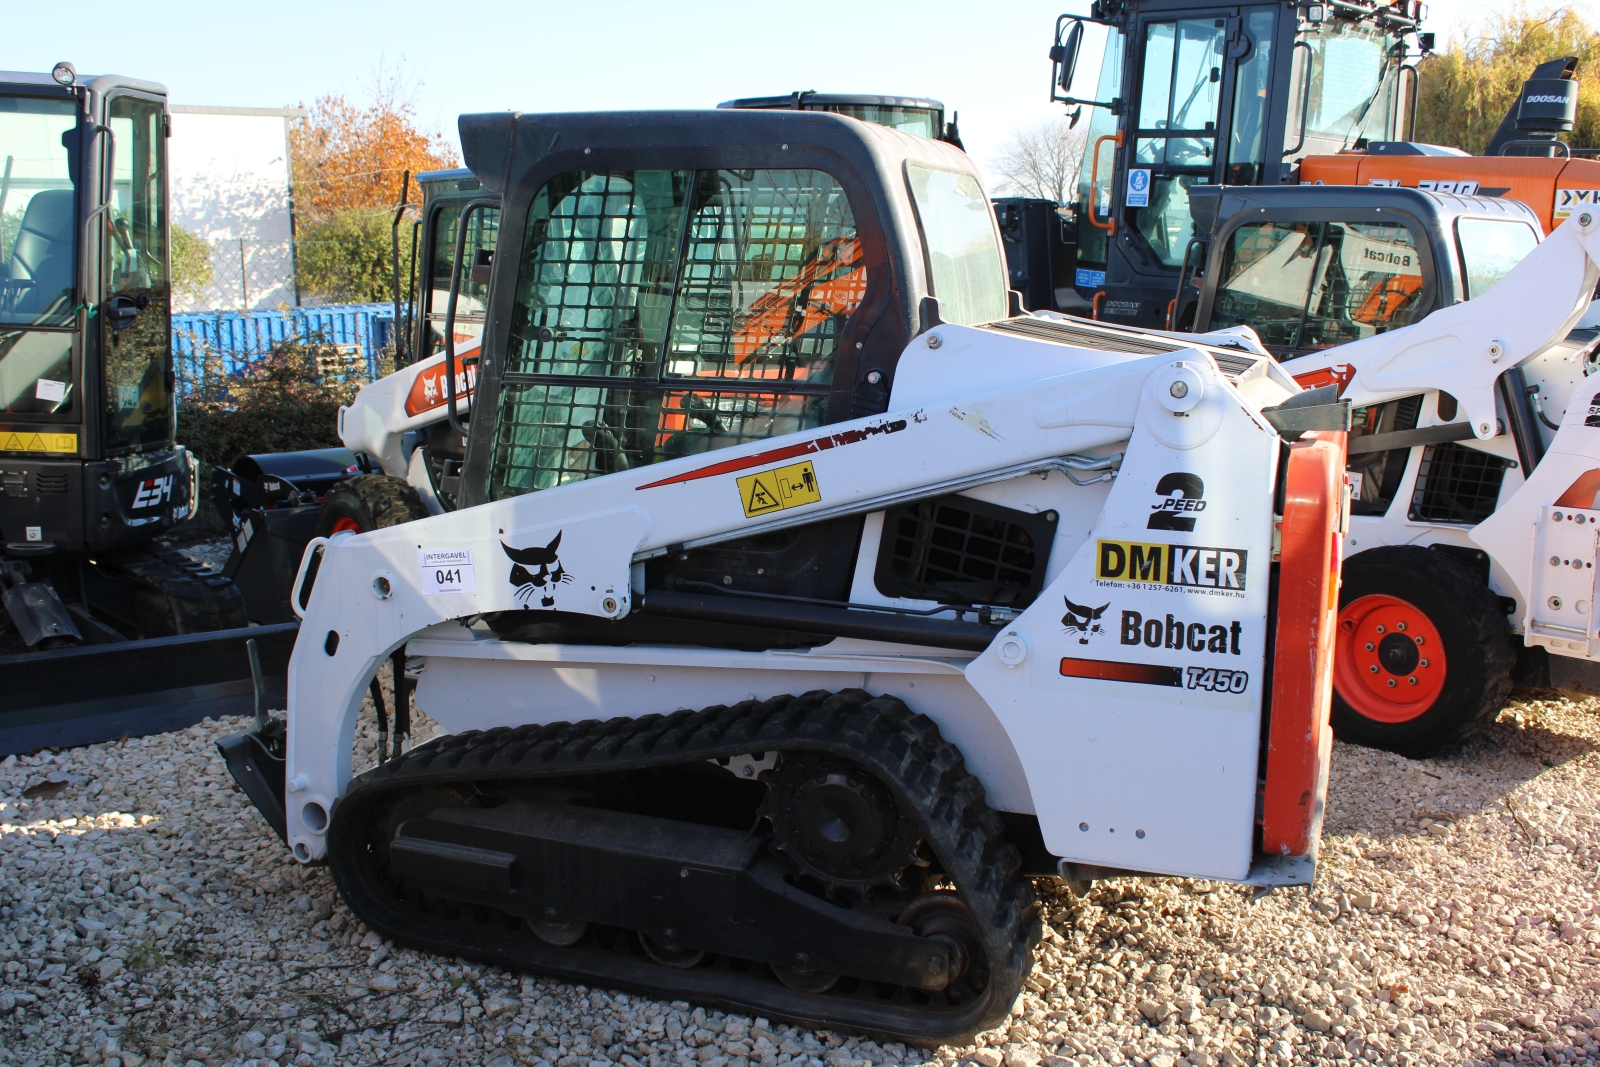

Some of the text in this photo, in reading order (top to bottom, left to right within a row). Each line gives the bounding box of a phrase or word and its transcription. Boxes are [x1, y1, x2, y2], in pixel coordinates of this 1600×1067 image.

[1526, 95, 1570, 104] DOOSAN
[131, 474, 173, 509] E34
[425, 551, 467, 561] INTERGAVEL
[436, 569, 461, 584] 041
[1095, 579, 1125, 589] Telefon:
[1126, 582, 1141, 590] +36
[1148, 584, 1186, 594] 257-6261,
[1187, 588, 1245, 599] www.dmker.hu
[1120, 610, 1242, 656] Bobcat
[1186, 666, 1249, 694] T450
